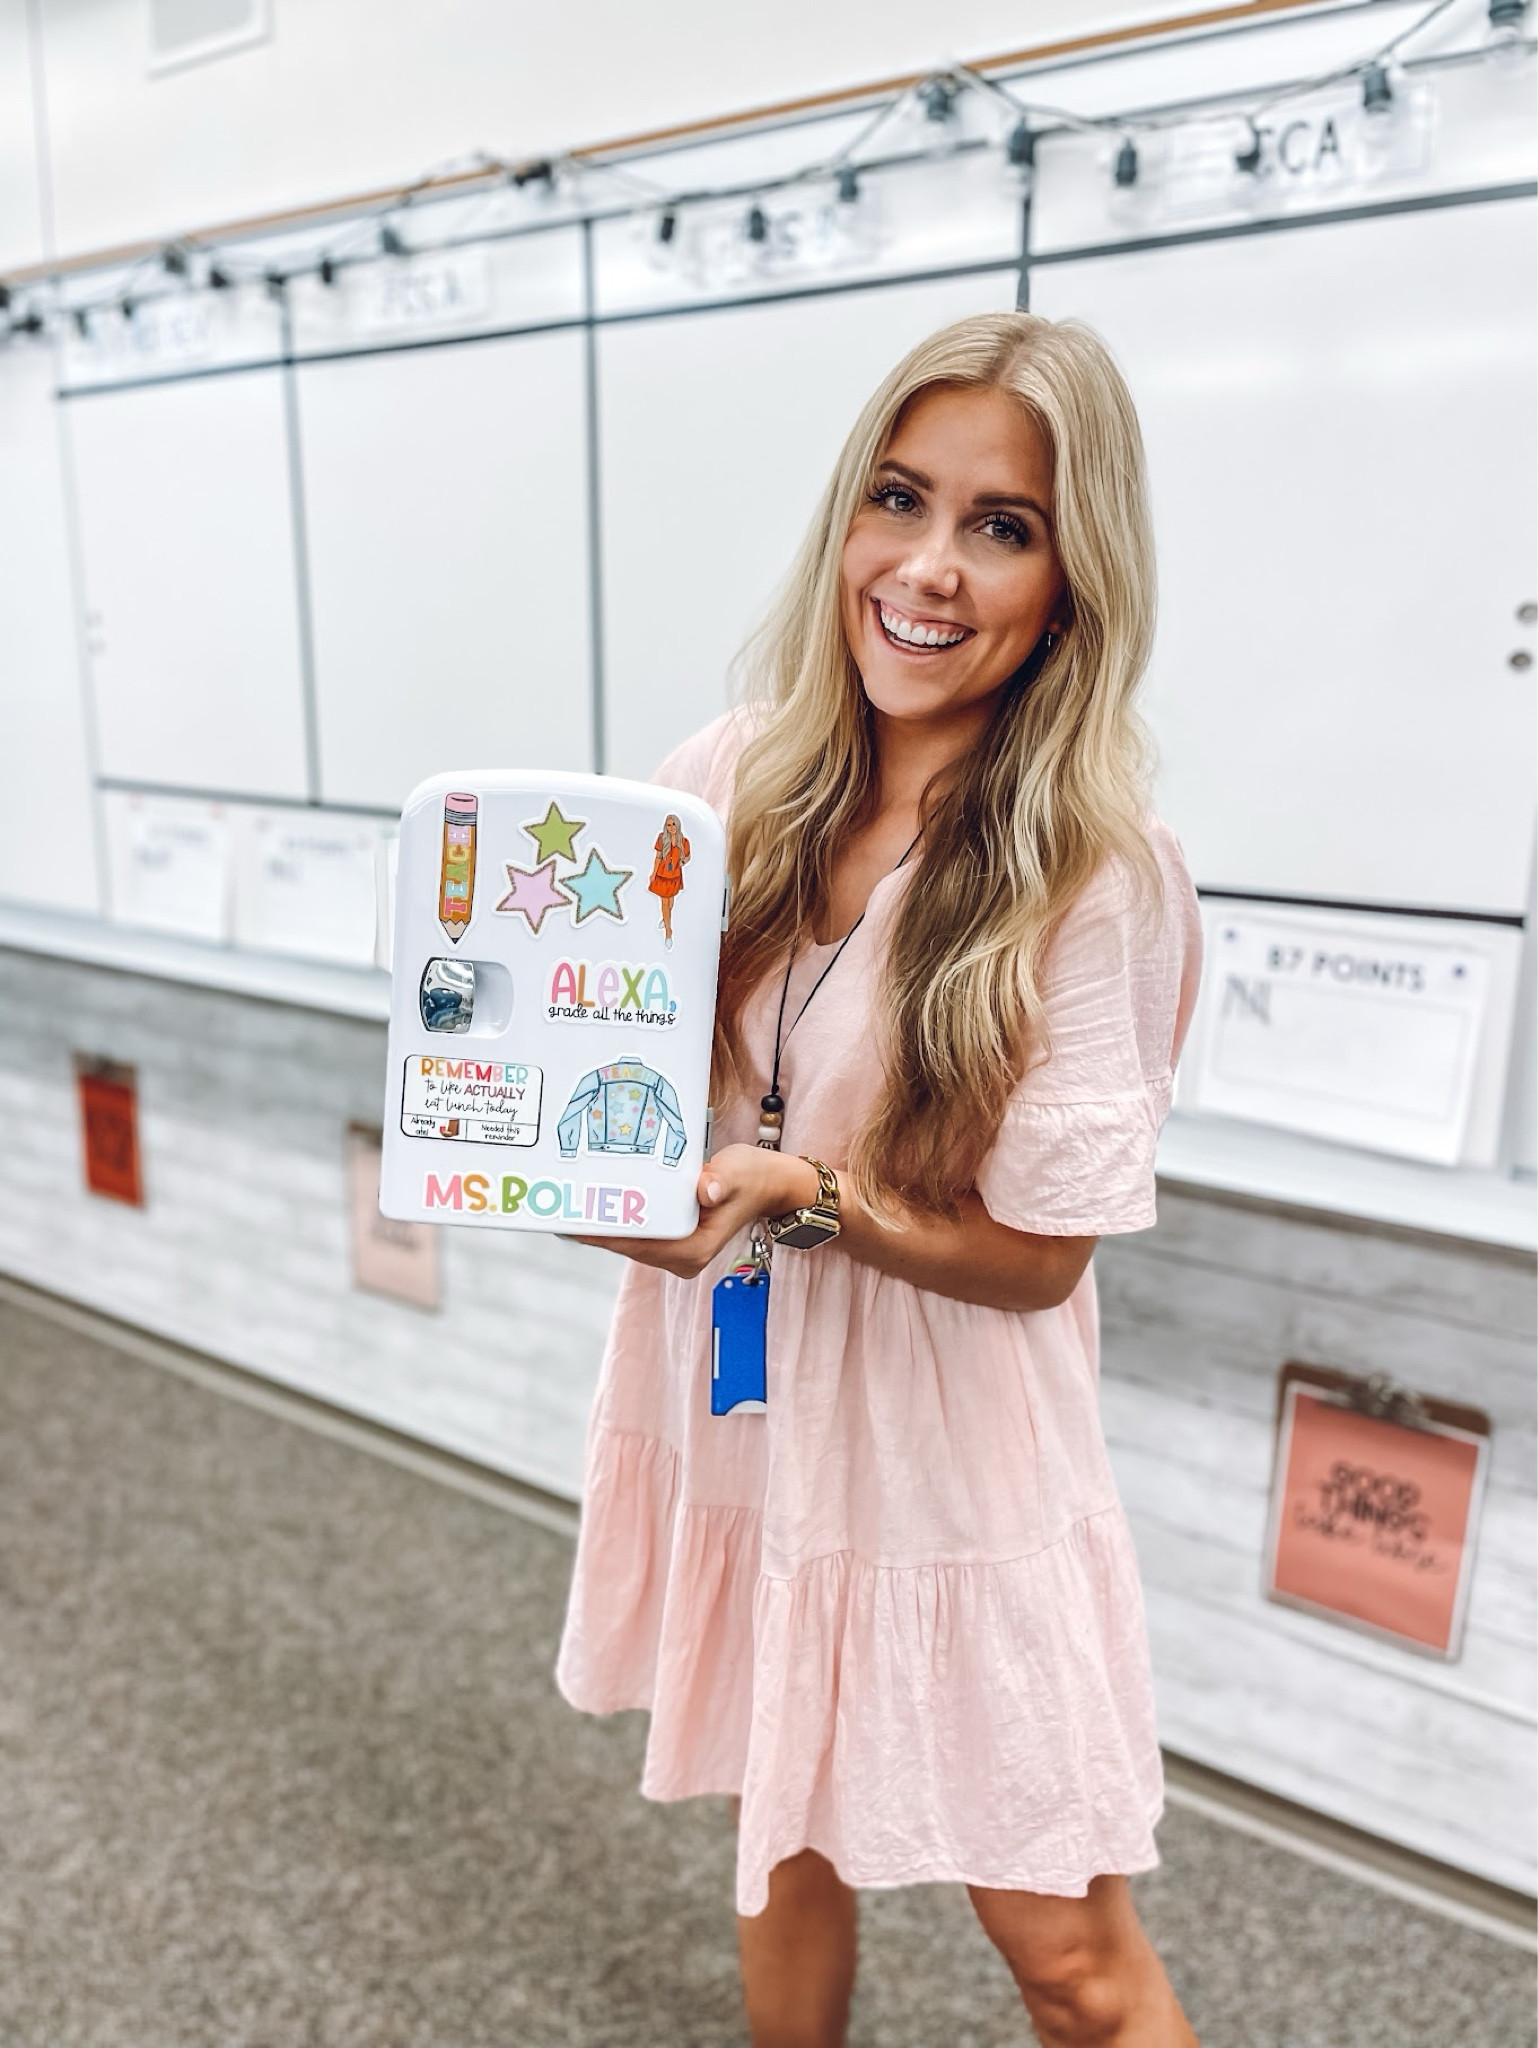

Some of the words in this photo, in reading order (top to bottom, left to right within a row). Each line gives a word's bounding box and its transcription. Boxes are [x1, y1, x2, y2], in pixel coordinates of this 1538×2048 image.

[444, 825, 471, 917] TEACH
[1312, 951, 1424, 992] POINTS
[548, 1002, 589, 1018] grade
[593, 1006, 610, 1020] all
[613, 1008, 633, 1022] the
[421, 1058, 529, 1085] REMEMBER
[425, 1078, 437, 1093] to
[440, 1080, 461, 1095] like
[464, 1083, 526, 1101] ACTUALLY
[425, 1097, 444, 1111] eat
[446, 1097, 483, 1113] lunch
[484, 1099, 518, 1121] today
[411, 1116, 436, 1129] Already
[481, 1124, 505, 1134] Needed
[506, 1124, 520, 1137] this
[484, 1133, 516, 1142] reminder
